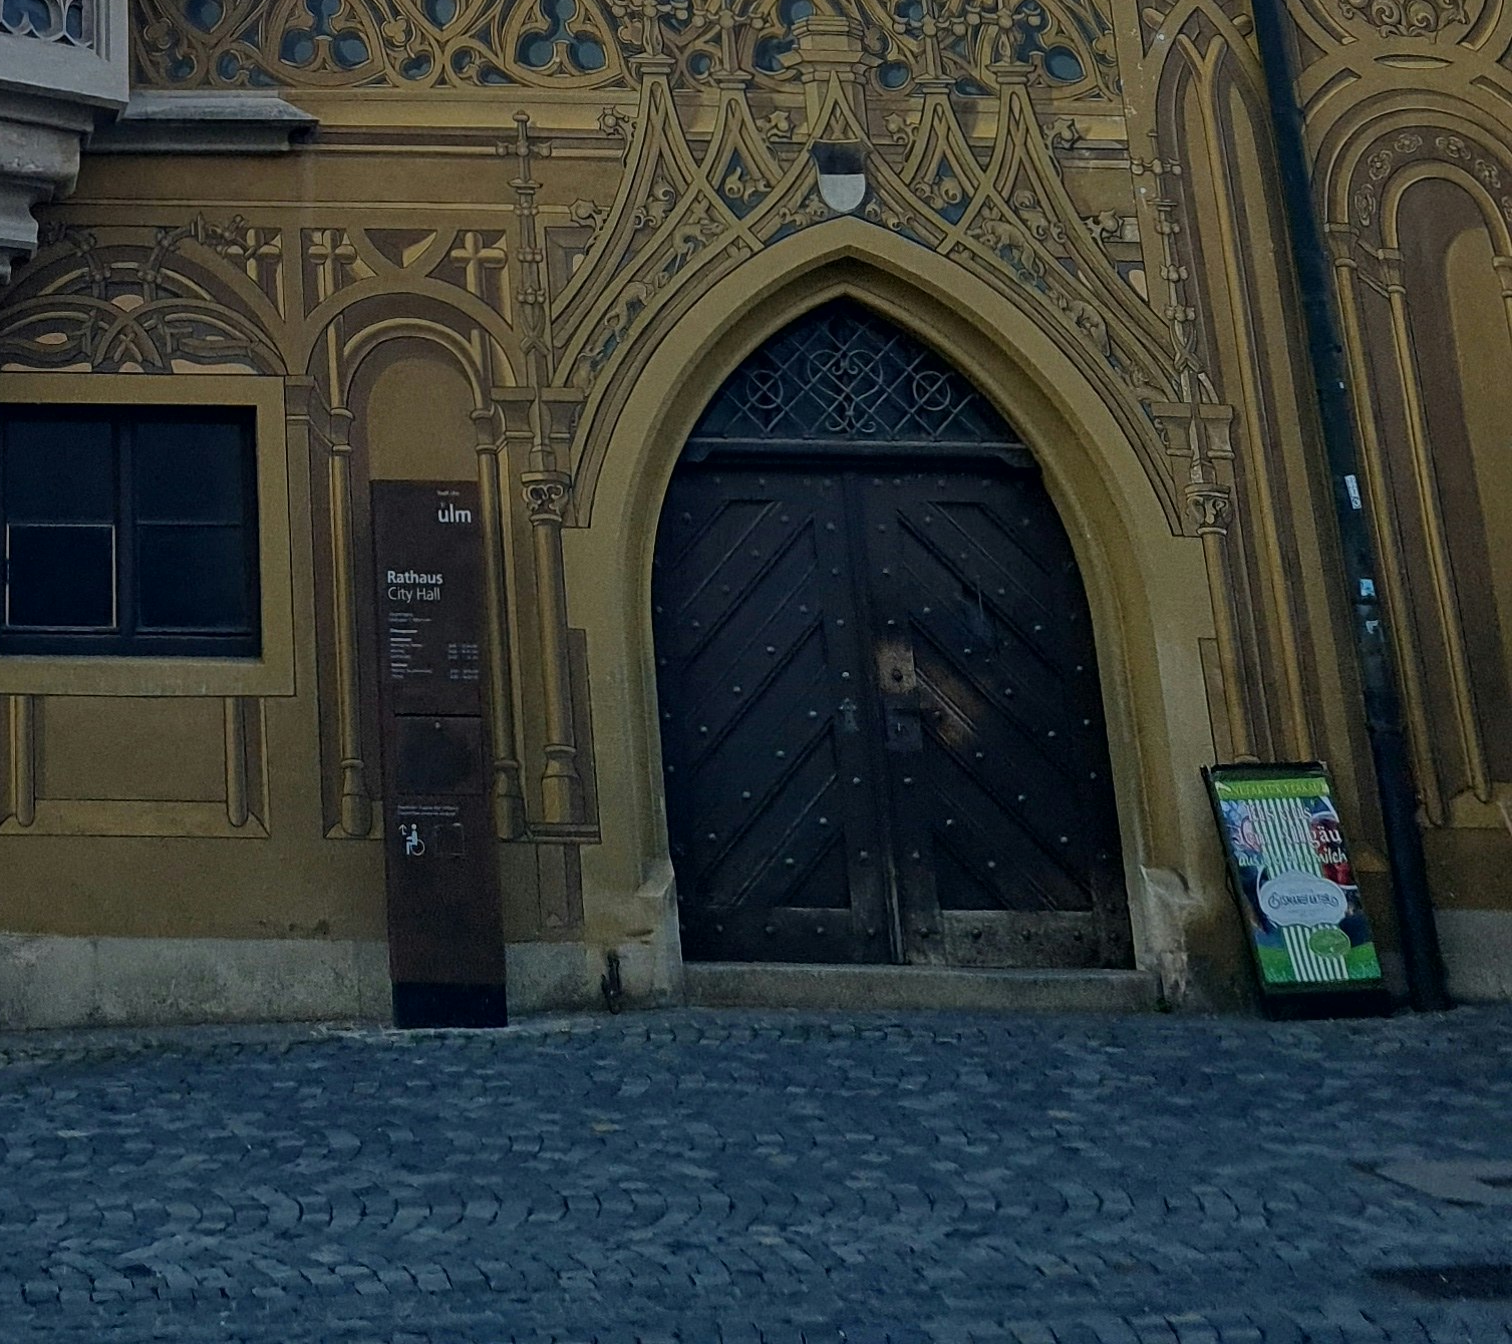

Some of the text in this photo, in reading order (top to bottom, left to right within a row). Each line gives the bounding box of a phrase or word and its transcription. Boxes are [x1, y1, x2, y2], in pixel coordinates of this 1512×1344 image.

[438, 503, 472, 524] ulm
[387, 569, 444, 585] Rathaus
[388, 586, 441, 604] City Hall
